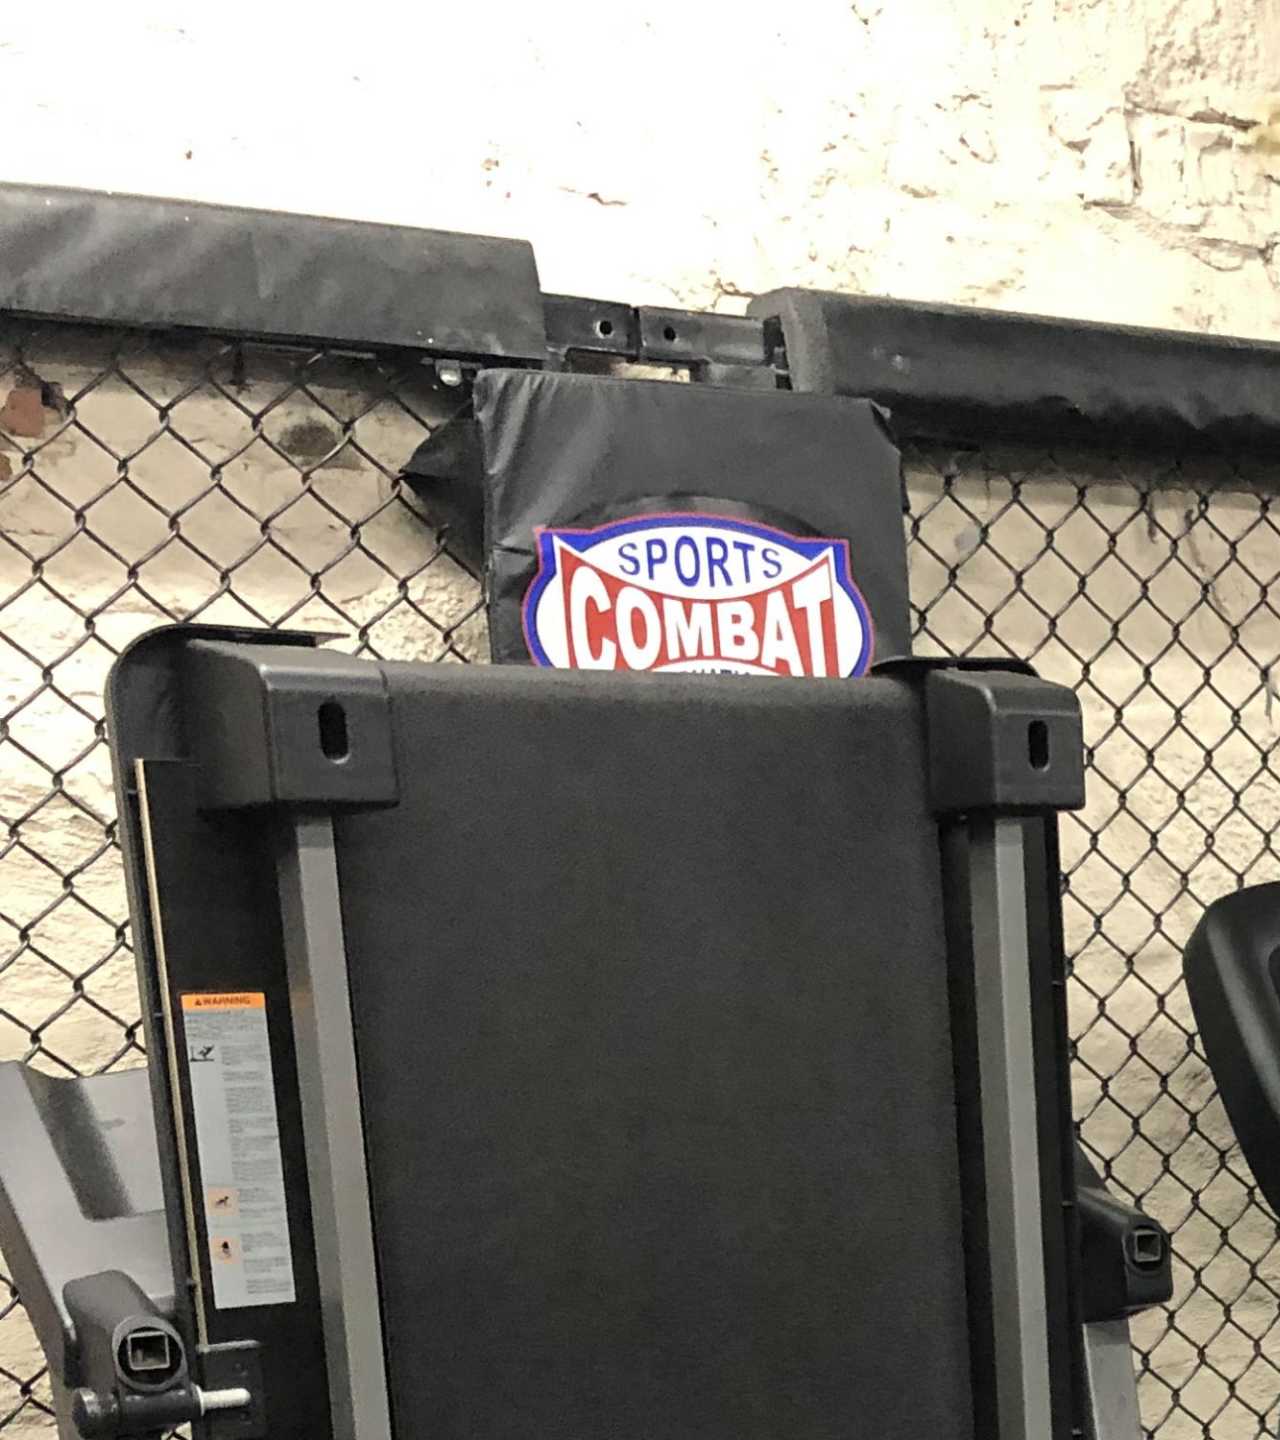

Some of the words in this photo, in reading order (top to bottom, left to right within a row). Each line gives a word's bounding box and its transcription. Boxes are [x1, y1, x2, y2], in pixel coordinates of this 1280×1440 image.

[617, 535, 784, 589] SPORTS
[568, 562, 840, 678] COMBAT
[203, 996, 251, 1006] WARNING
